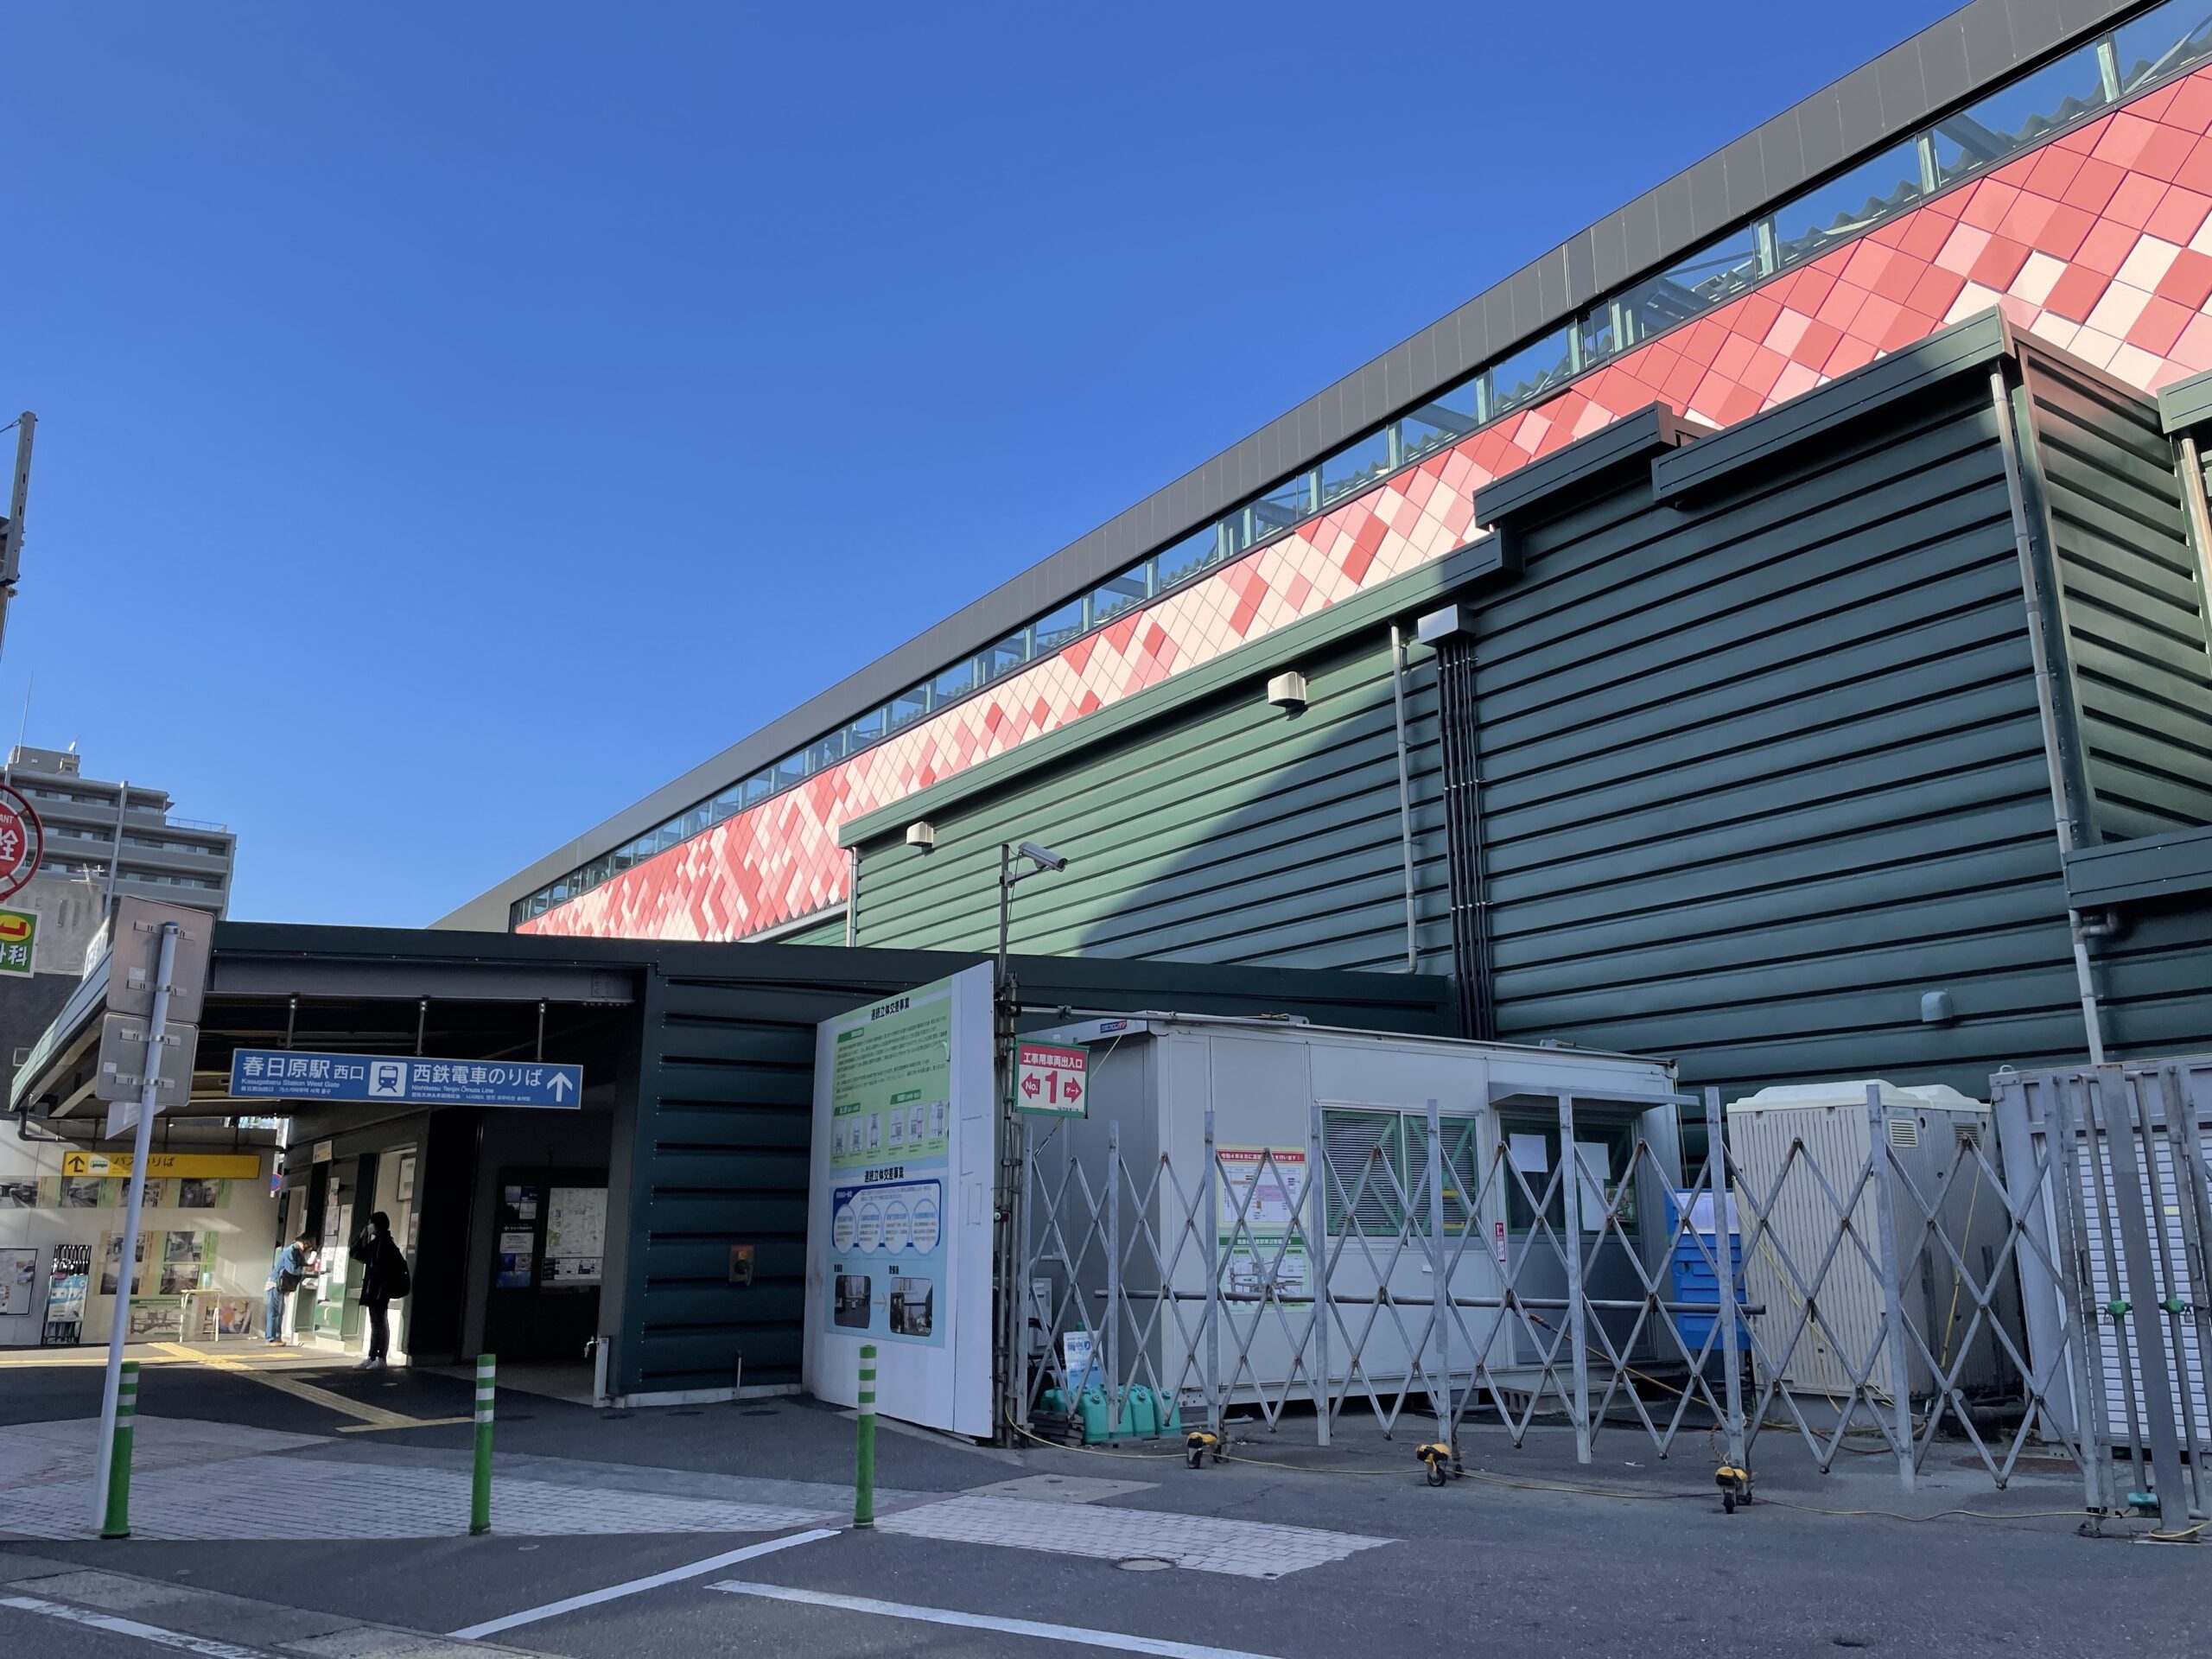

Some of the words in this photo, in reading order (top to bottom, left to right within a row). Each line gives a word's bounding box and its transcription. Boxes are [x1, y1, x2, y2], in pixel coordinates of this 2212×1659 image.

[243, 1056, 330, 1078] 春日原駅
[334, 1065, 365, 1080] 西口
[1023, 1052, 1083, 1069] 工事用車両出入口
[413, 1064, 543, 1086] 西鉄電車のりば
[1025, 1081, 1038, 1090] No.
[1045, 1071, 1058, 1103] 1
[113, 1156, 175, 1166] バスりば
